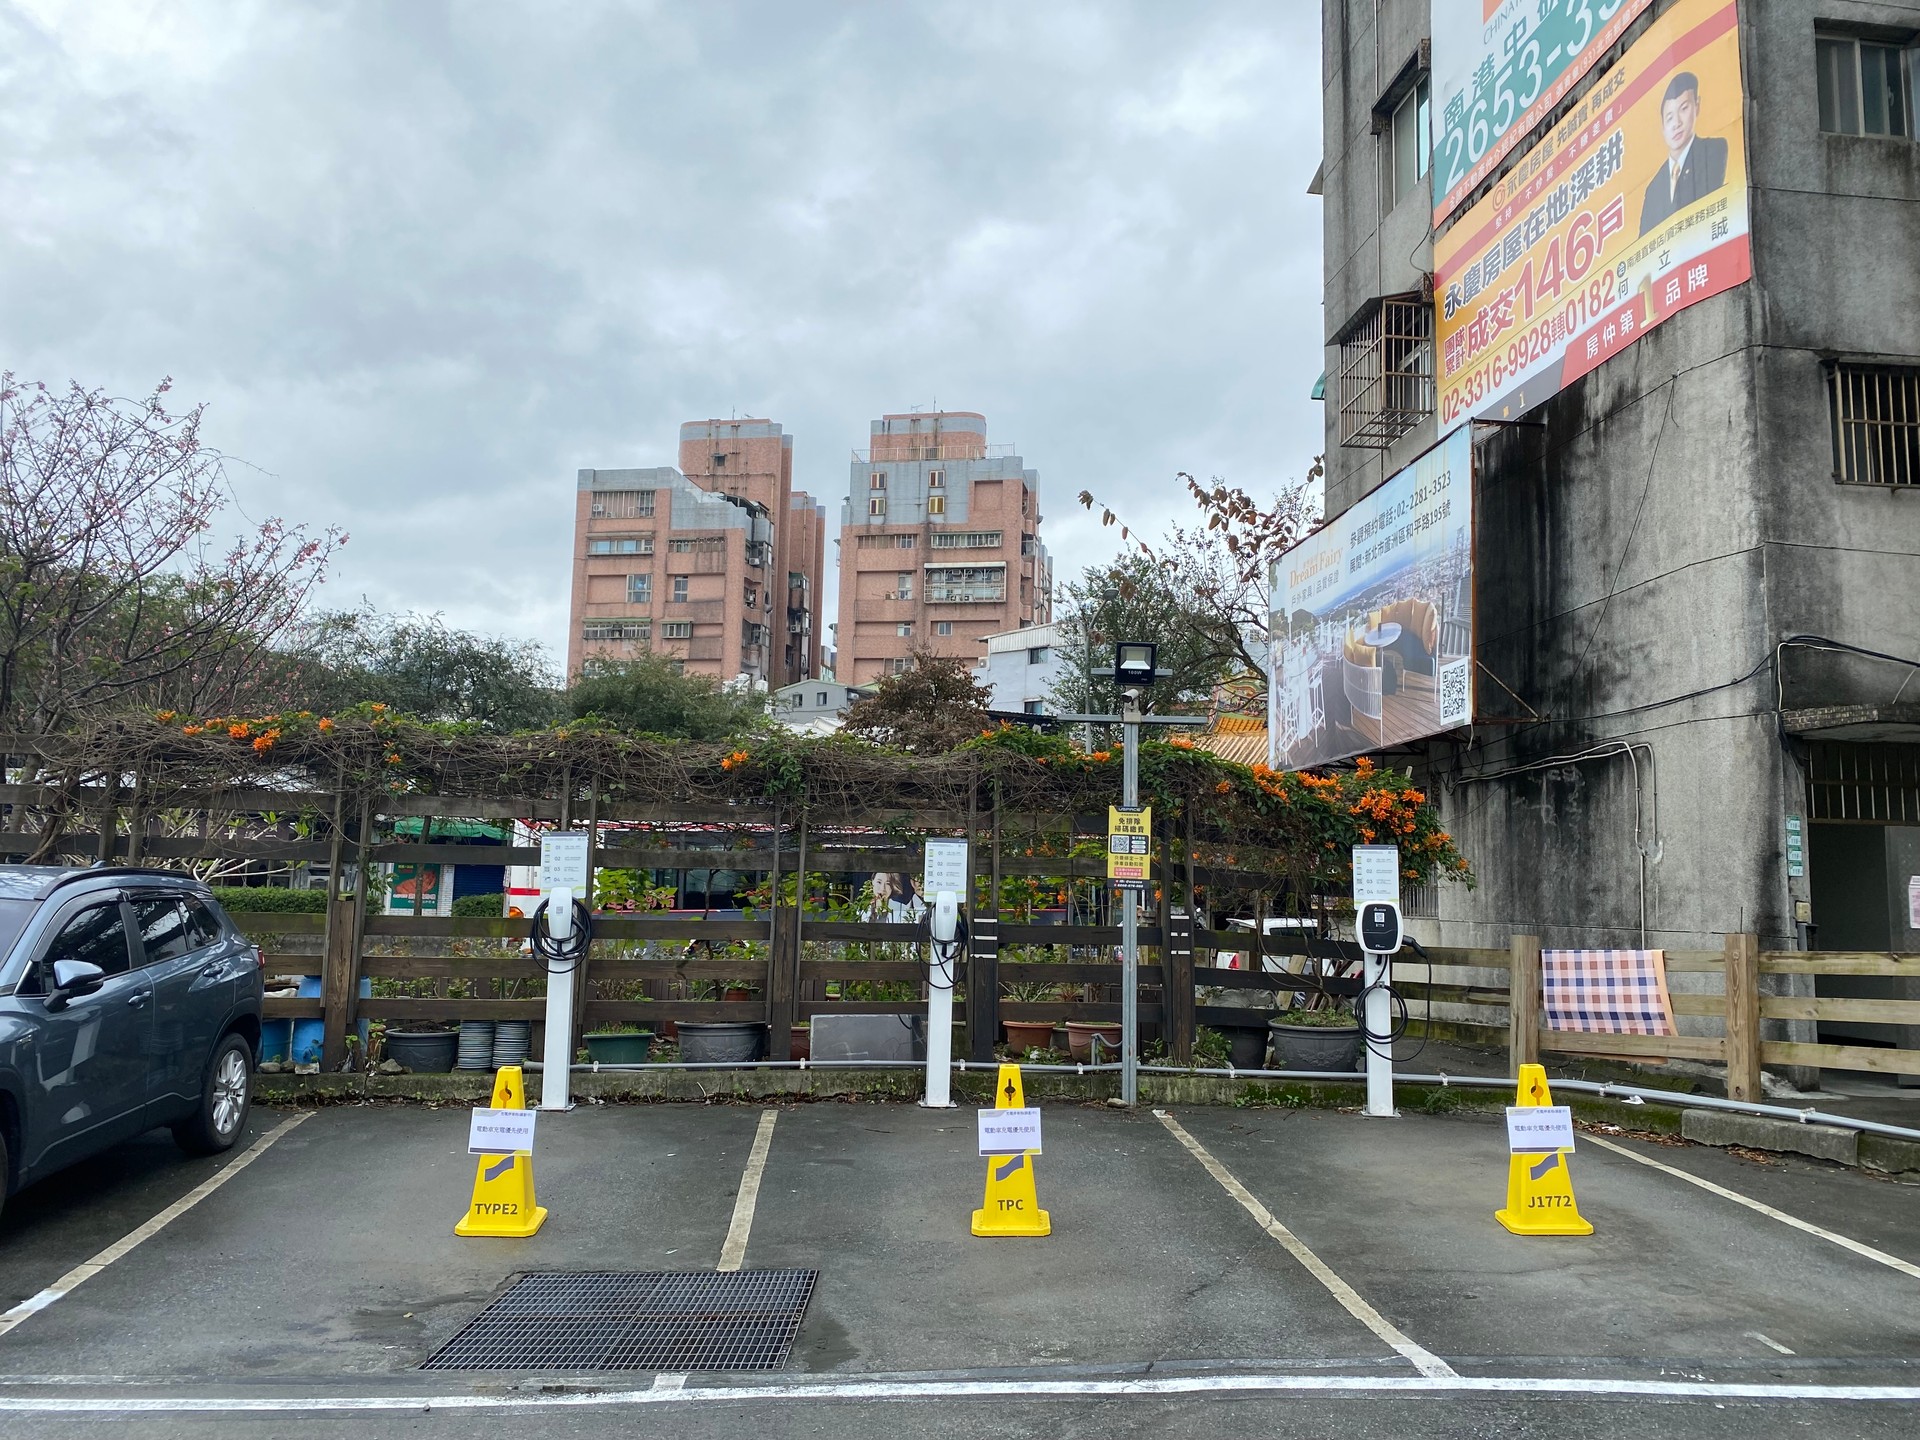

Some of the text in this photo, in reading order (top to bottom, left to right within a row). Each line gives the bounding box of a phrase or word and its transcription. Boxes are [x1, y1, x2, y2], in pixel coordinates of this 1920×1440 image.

[1507, 67, 1625, 198] 永慶房屋 先誠實 再成交
[1443, 130, 1624, 320] 永慶房屋在地深耕
[1466, 193, 1624, 359] 成交146戶
[1442, 269, 1616, 425] 02-3316-9928轉0182
[1290, 563, 1318, 589] Dream
[1319, 547, 1343, 571] Fairy
[474, 1203, 518, 1215] TYPE2
[997, 1199, 1024, 1211] TPC
[1528, 1195, 1572, 1208] J1772
